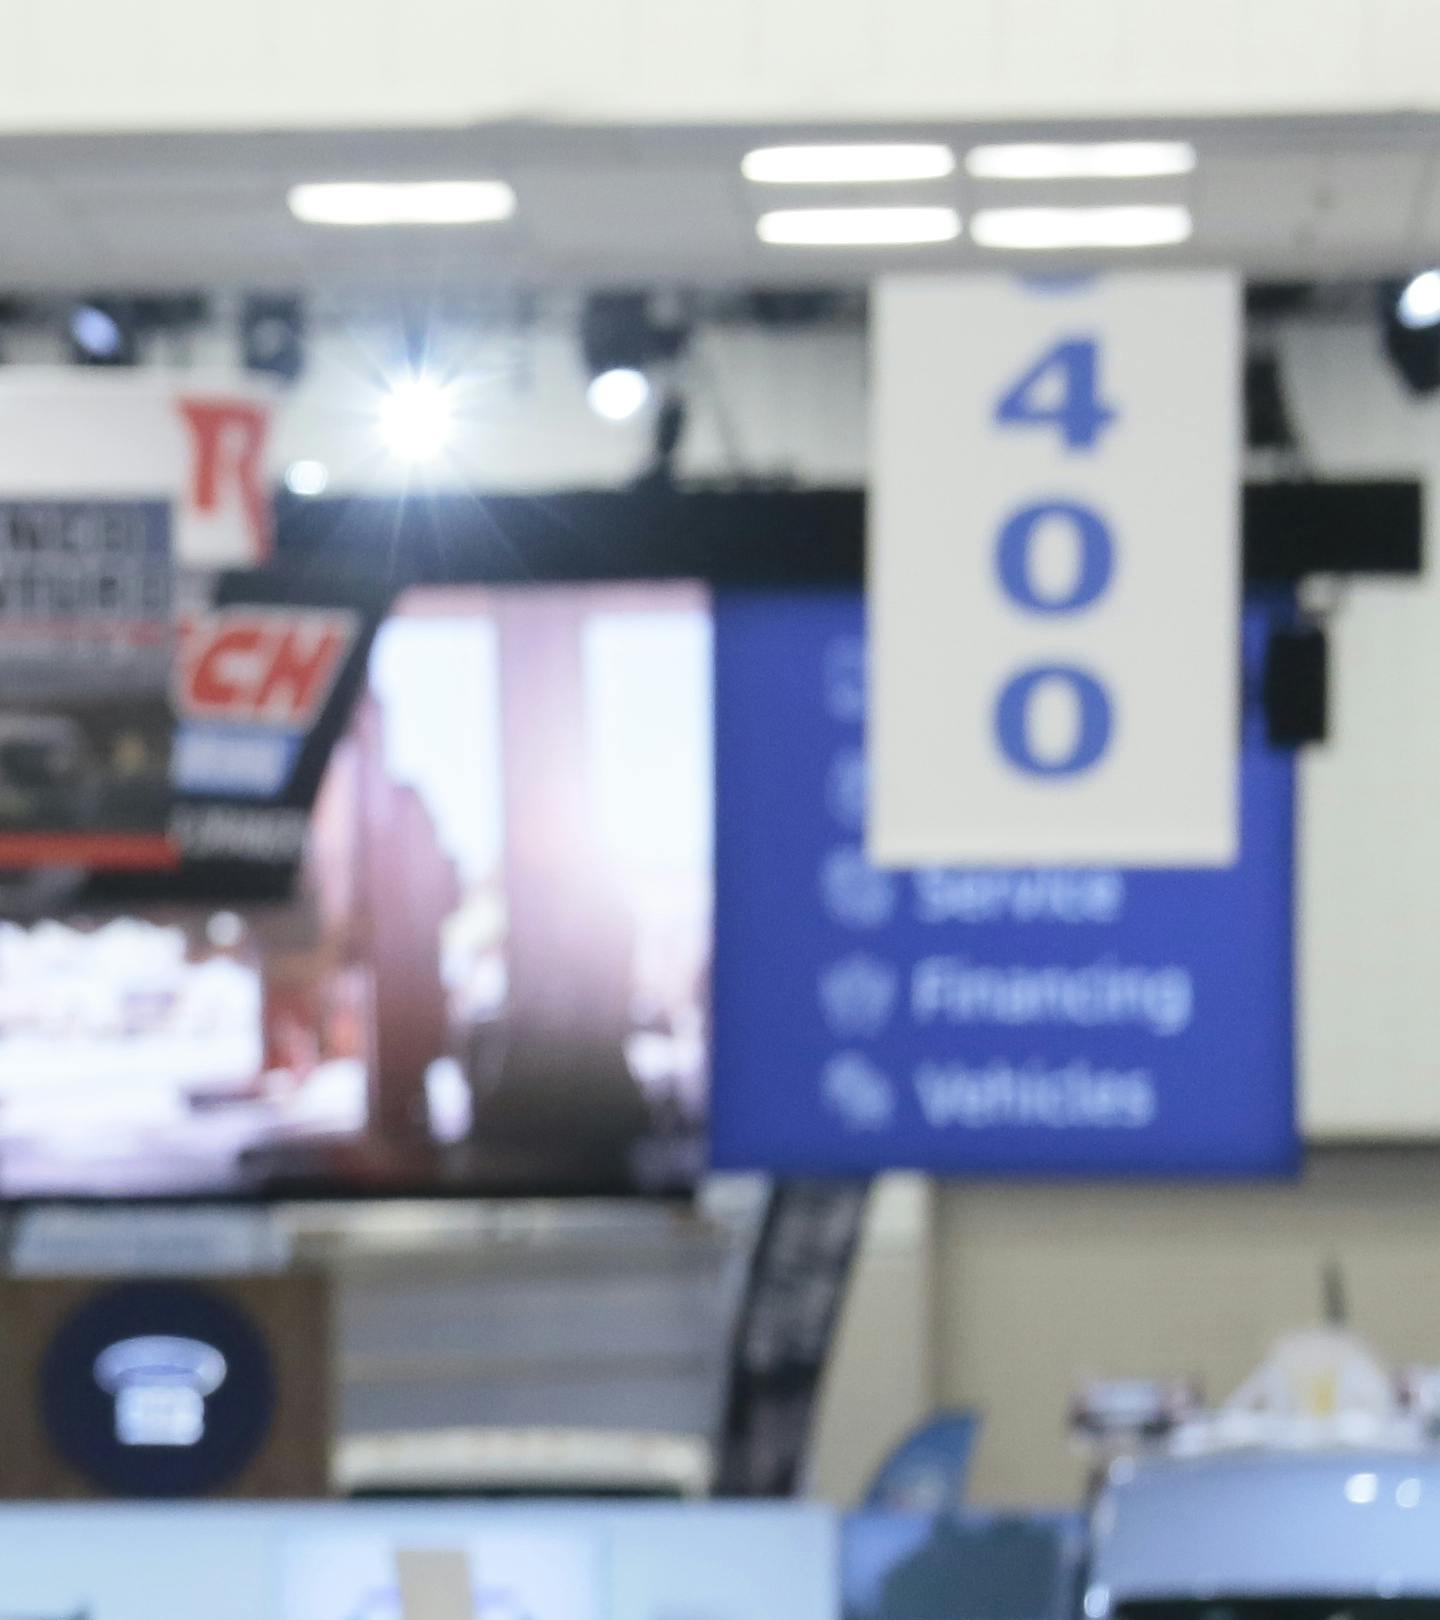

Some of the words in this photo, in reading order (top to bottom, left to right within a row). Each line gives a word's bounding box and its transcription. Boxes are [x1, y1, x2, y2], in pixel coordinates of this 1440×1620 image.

[988, 334, 1118, 784] 400
[912, 957, 1192, 1038] Financing
[914, 1060, 1154, 1128] Vehicles
